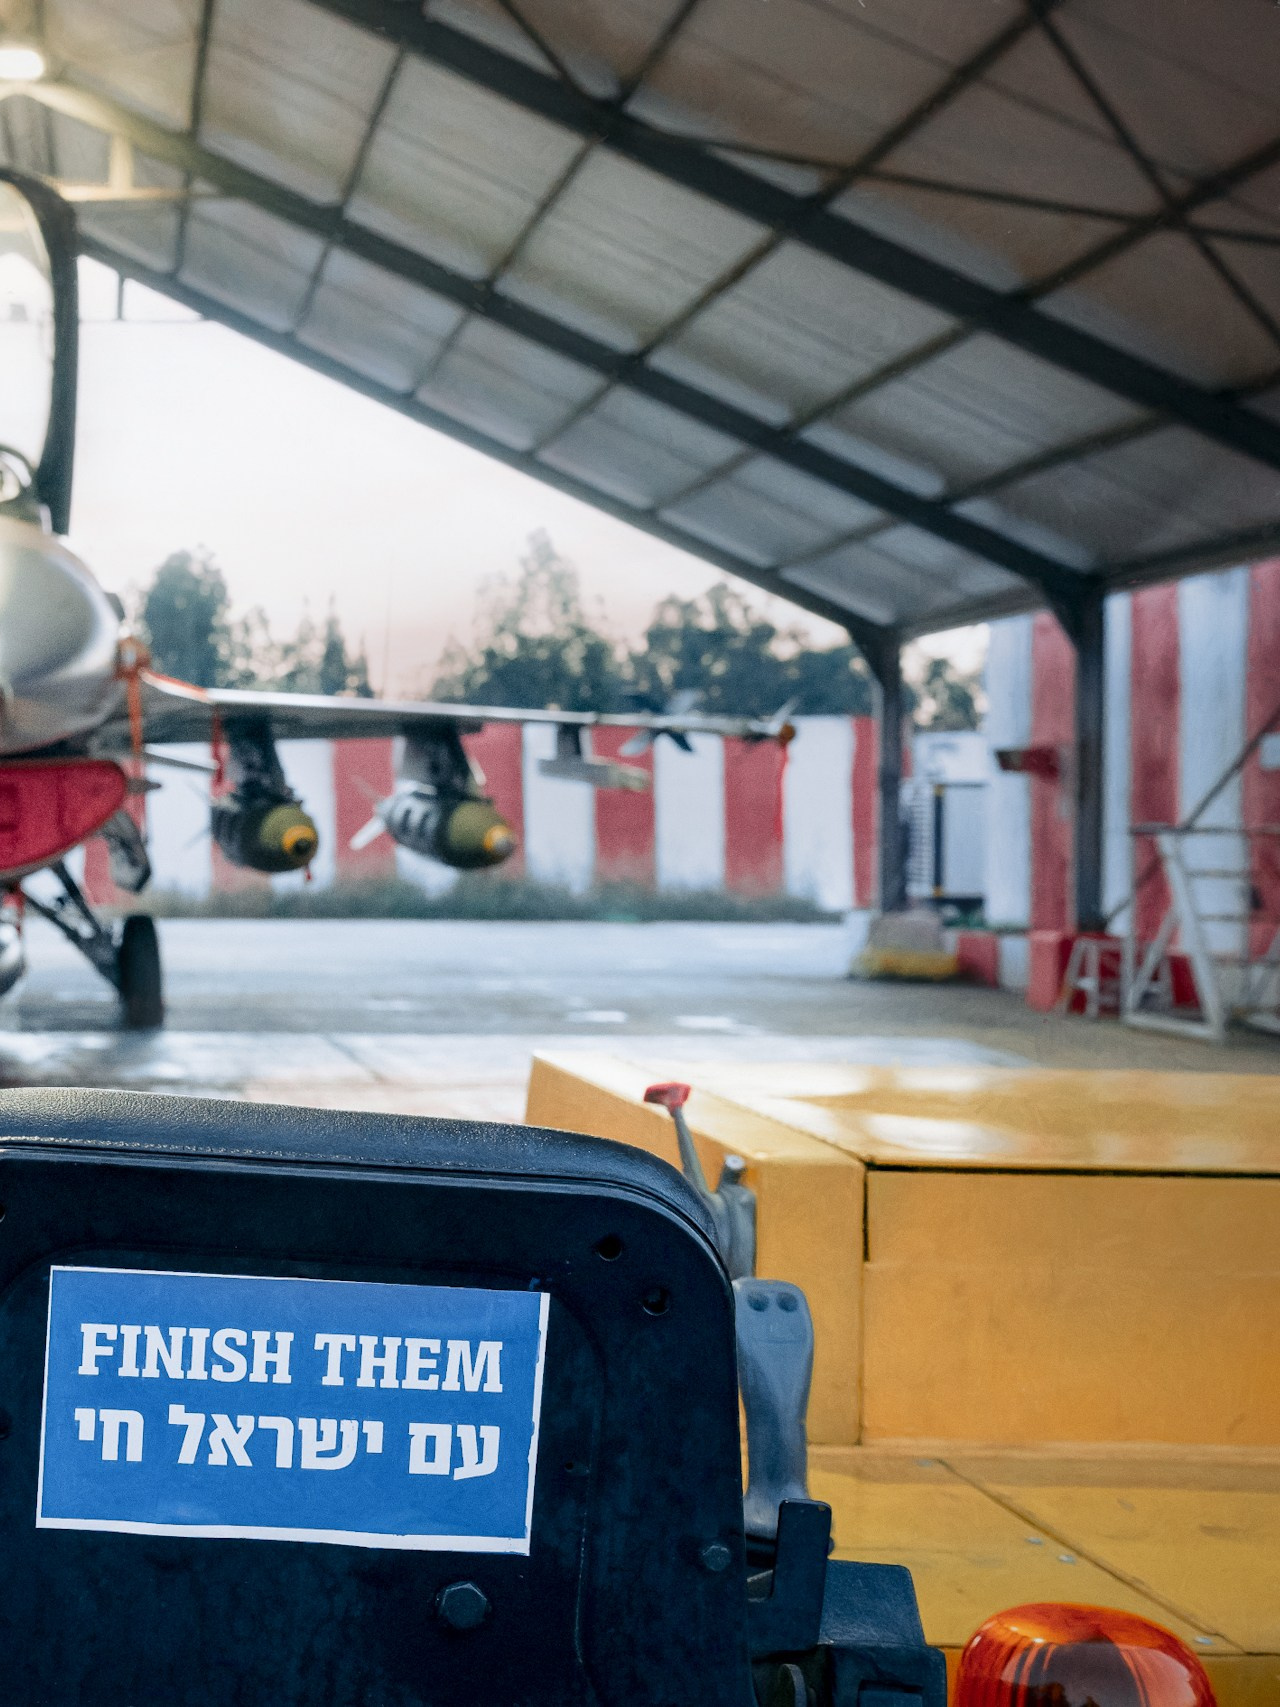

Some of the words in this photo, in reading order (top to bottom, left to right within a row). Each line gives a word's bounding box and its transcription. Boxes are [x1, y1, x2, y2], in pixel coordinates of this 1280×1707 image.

[78, 1323, 295, 1384] FINISH
[313, 1333, 503, 1393] THEM
[74, 1407, 145, 1462] חי
[168, 1404, 384, 1471] ישראל
[408, 1422, 500, 1481] עם
